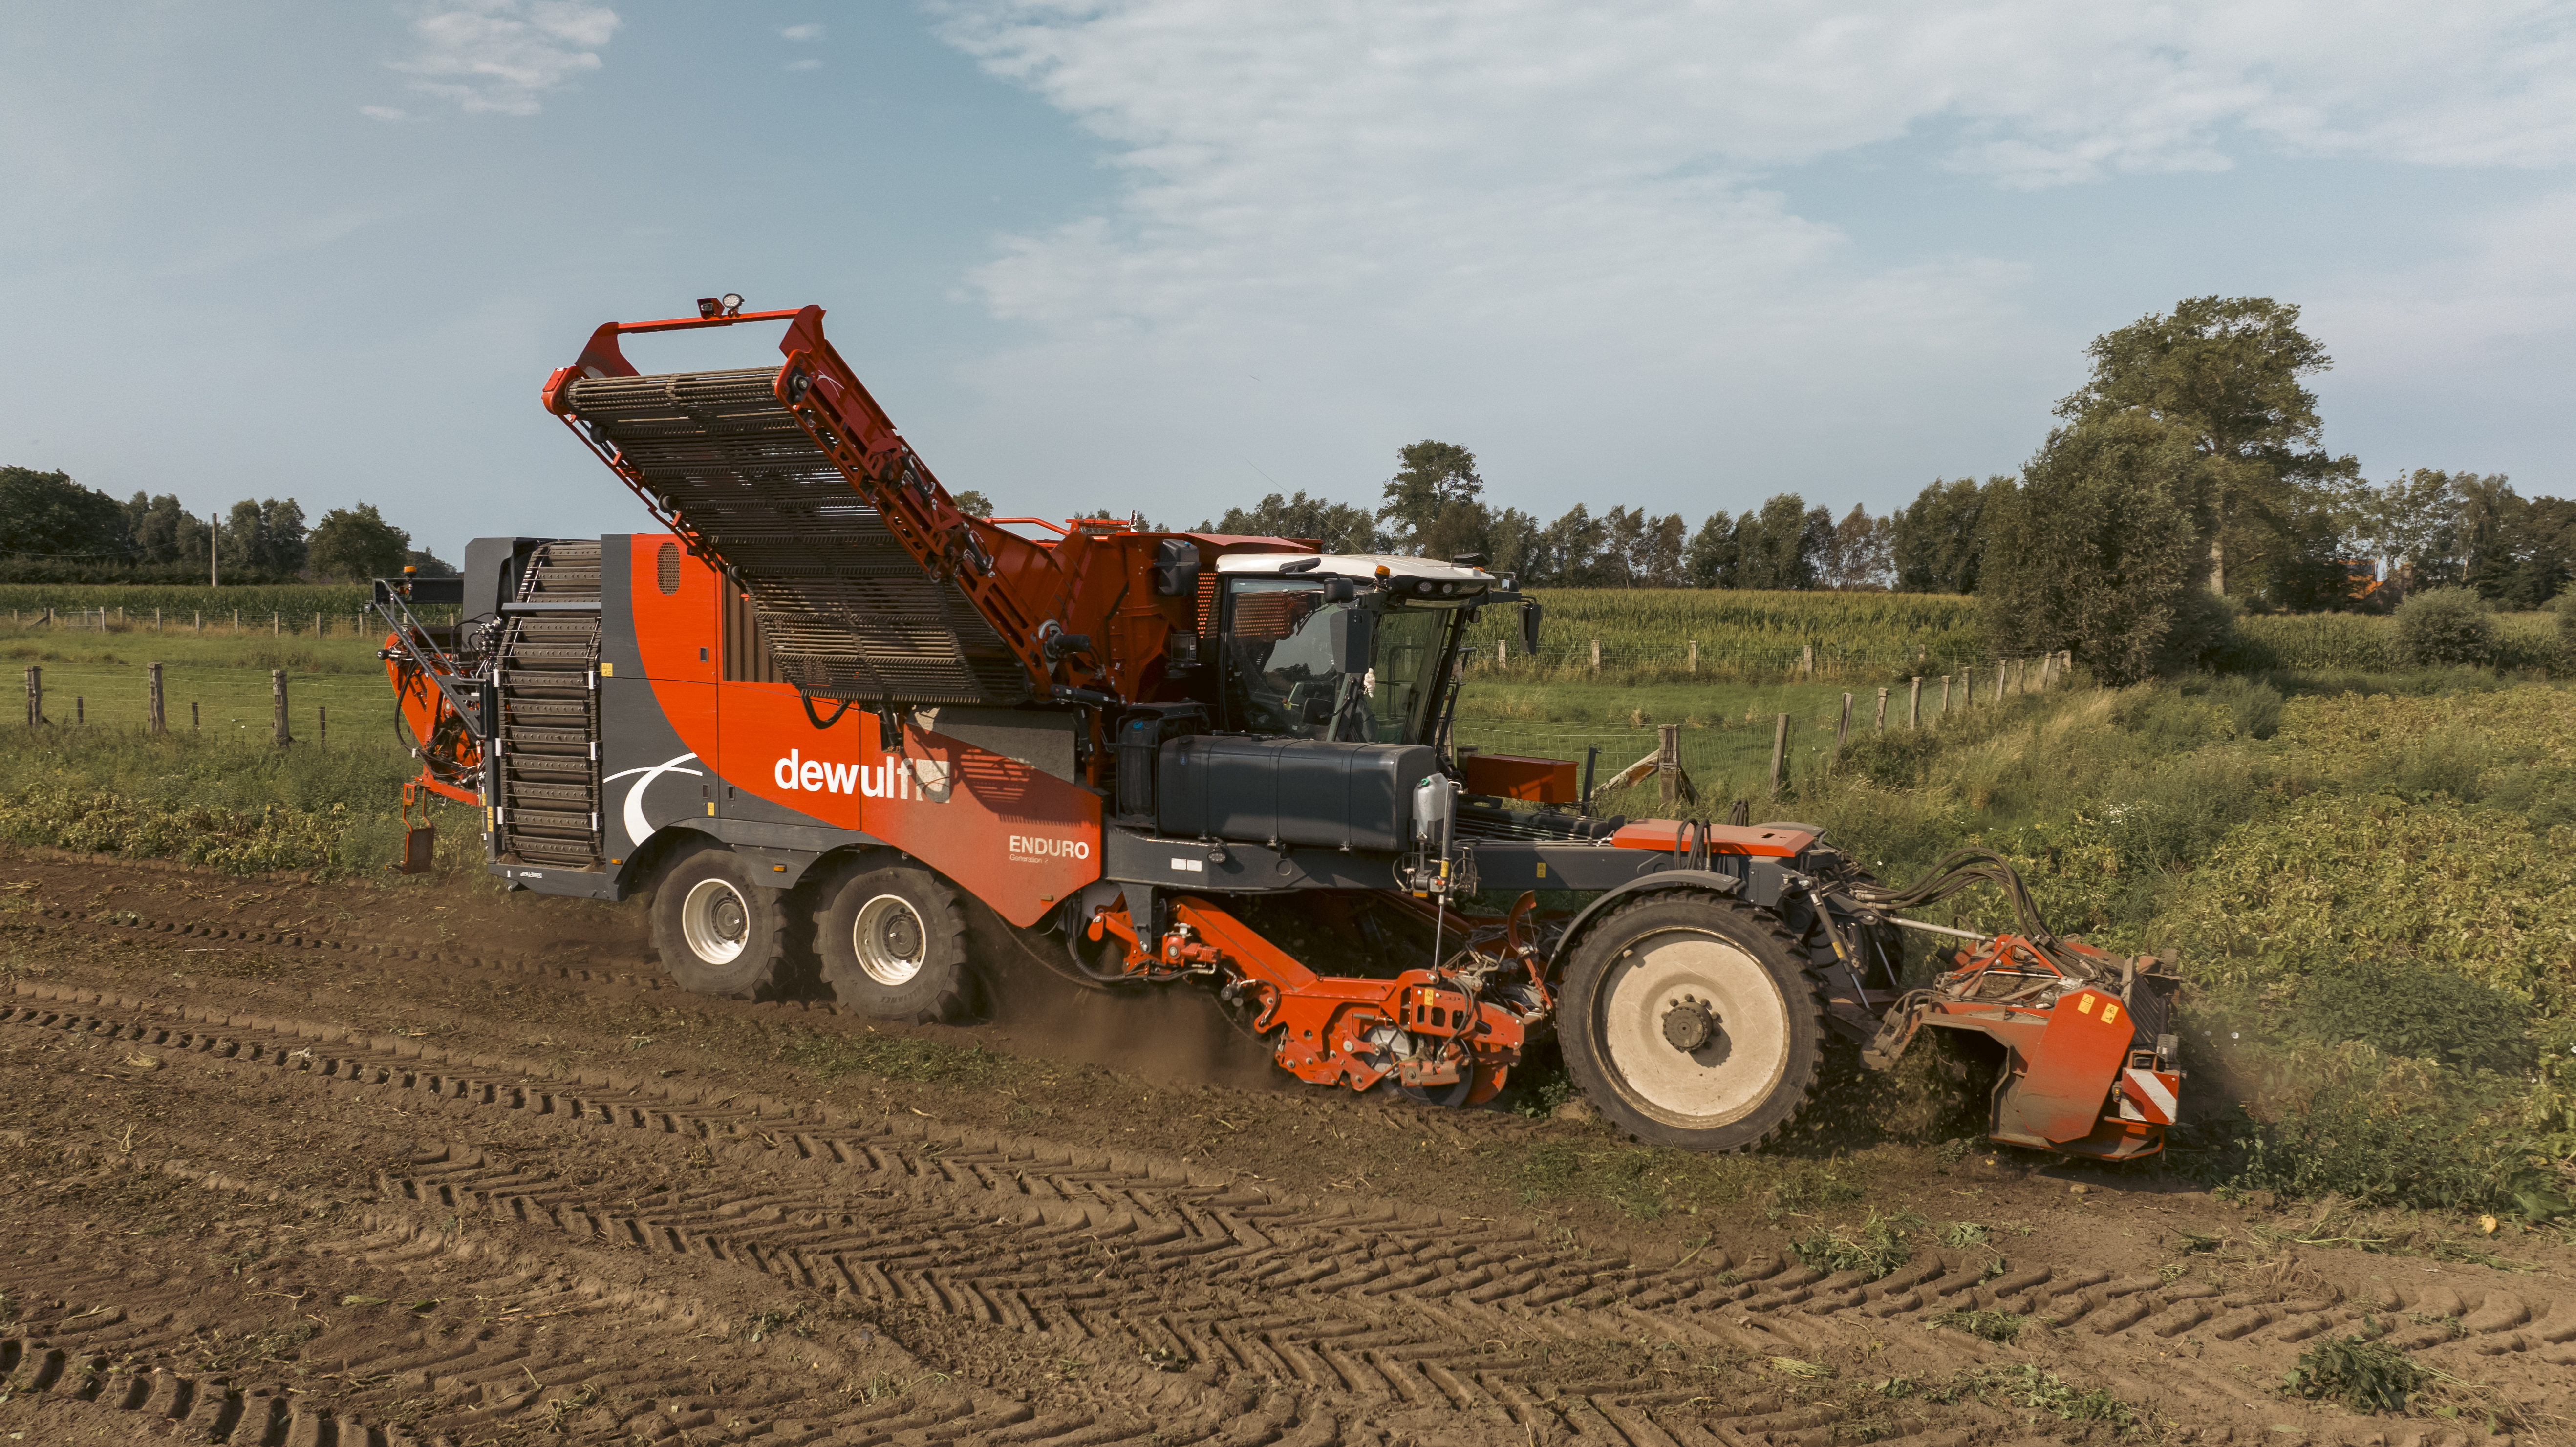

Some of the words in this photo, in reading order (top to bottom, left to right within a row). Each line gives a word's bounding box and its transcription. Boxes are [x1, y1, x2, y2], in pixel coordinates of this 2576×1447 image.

[774, 748, 913, 799] dewulf
[1009, 835, 1089, 859] ENDURO
[1009, 853, 1043, 863] Generation
